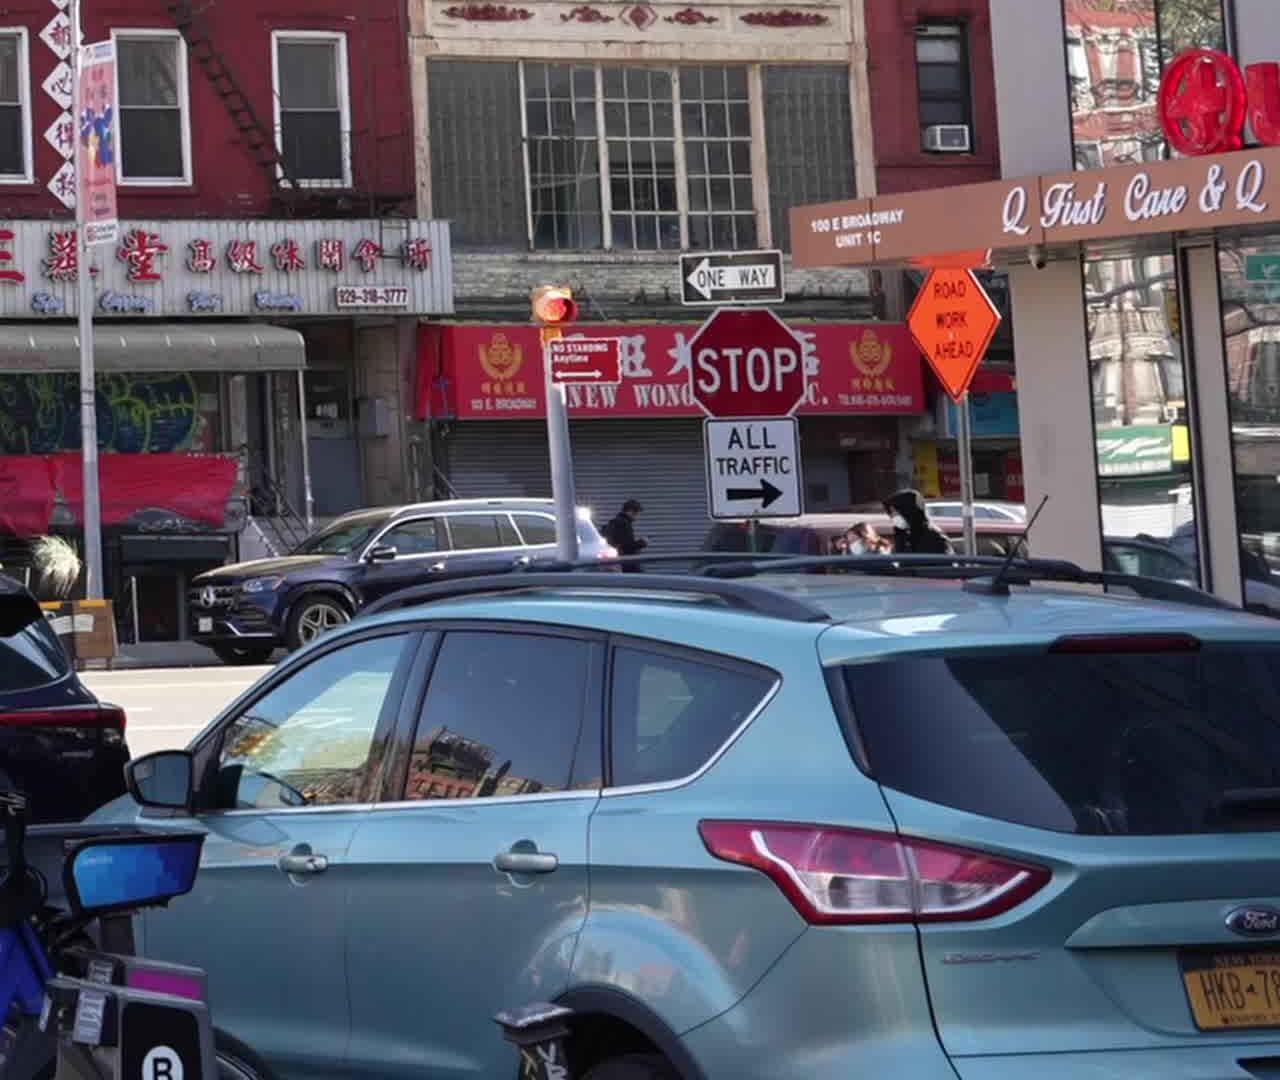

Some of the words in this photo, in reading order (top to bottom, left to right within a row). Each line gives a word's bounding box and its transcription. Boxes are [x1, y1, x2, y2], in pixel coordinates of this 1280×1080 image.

[1002, 186, 1030, 235] Q
[1041, 181, 1107, 228] First
[1124, 173, 1188, 222] Care
[1200, 164, 1226, 213] &
[1236, 159, 1267, 213] Q
[832, 217, 840, 232] E
[840, 209, 904, 230] BROADWAY
[835, 233, 860, 248] UNIT
[697, 271, 726, 289] ONE
[739, 264, 772, 286] WAY
[934, 280, 966, 298] ROAD
[936, 312, 968, 329] WORK
[552, 344, 566, 353] NO
[567, 343, 609, 353] STANDING
[934, 343, 974, 359] AHEAD
[697, 347, 799, 393] STOP
[568, 383, 617, 409] NEW
[728, 428, 776, 450] ALL
[716, 457, 790, 476] TRAFFIC
